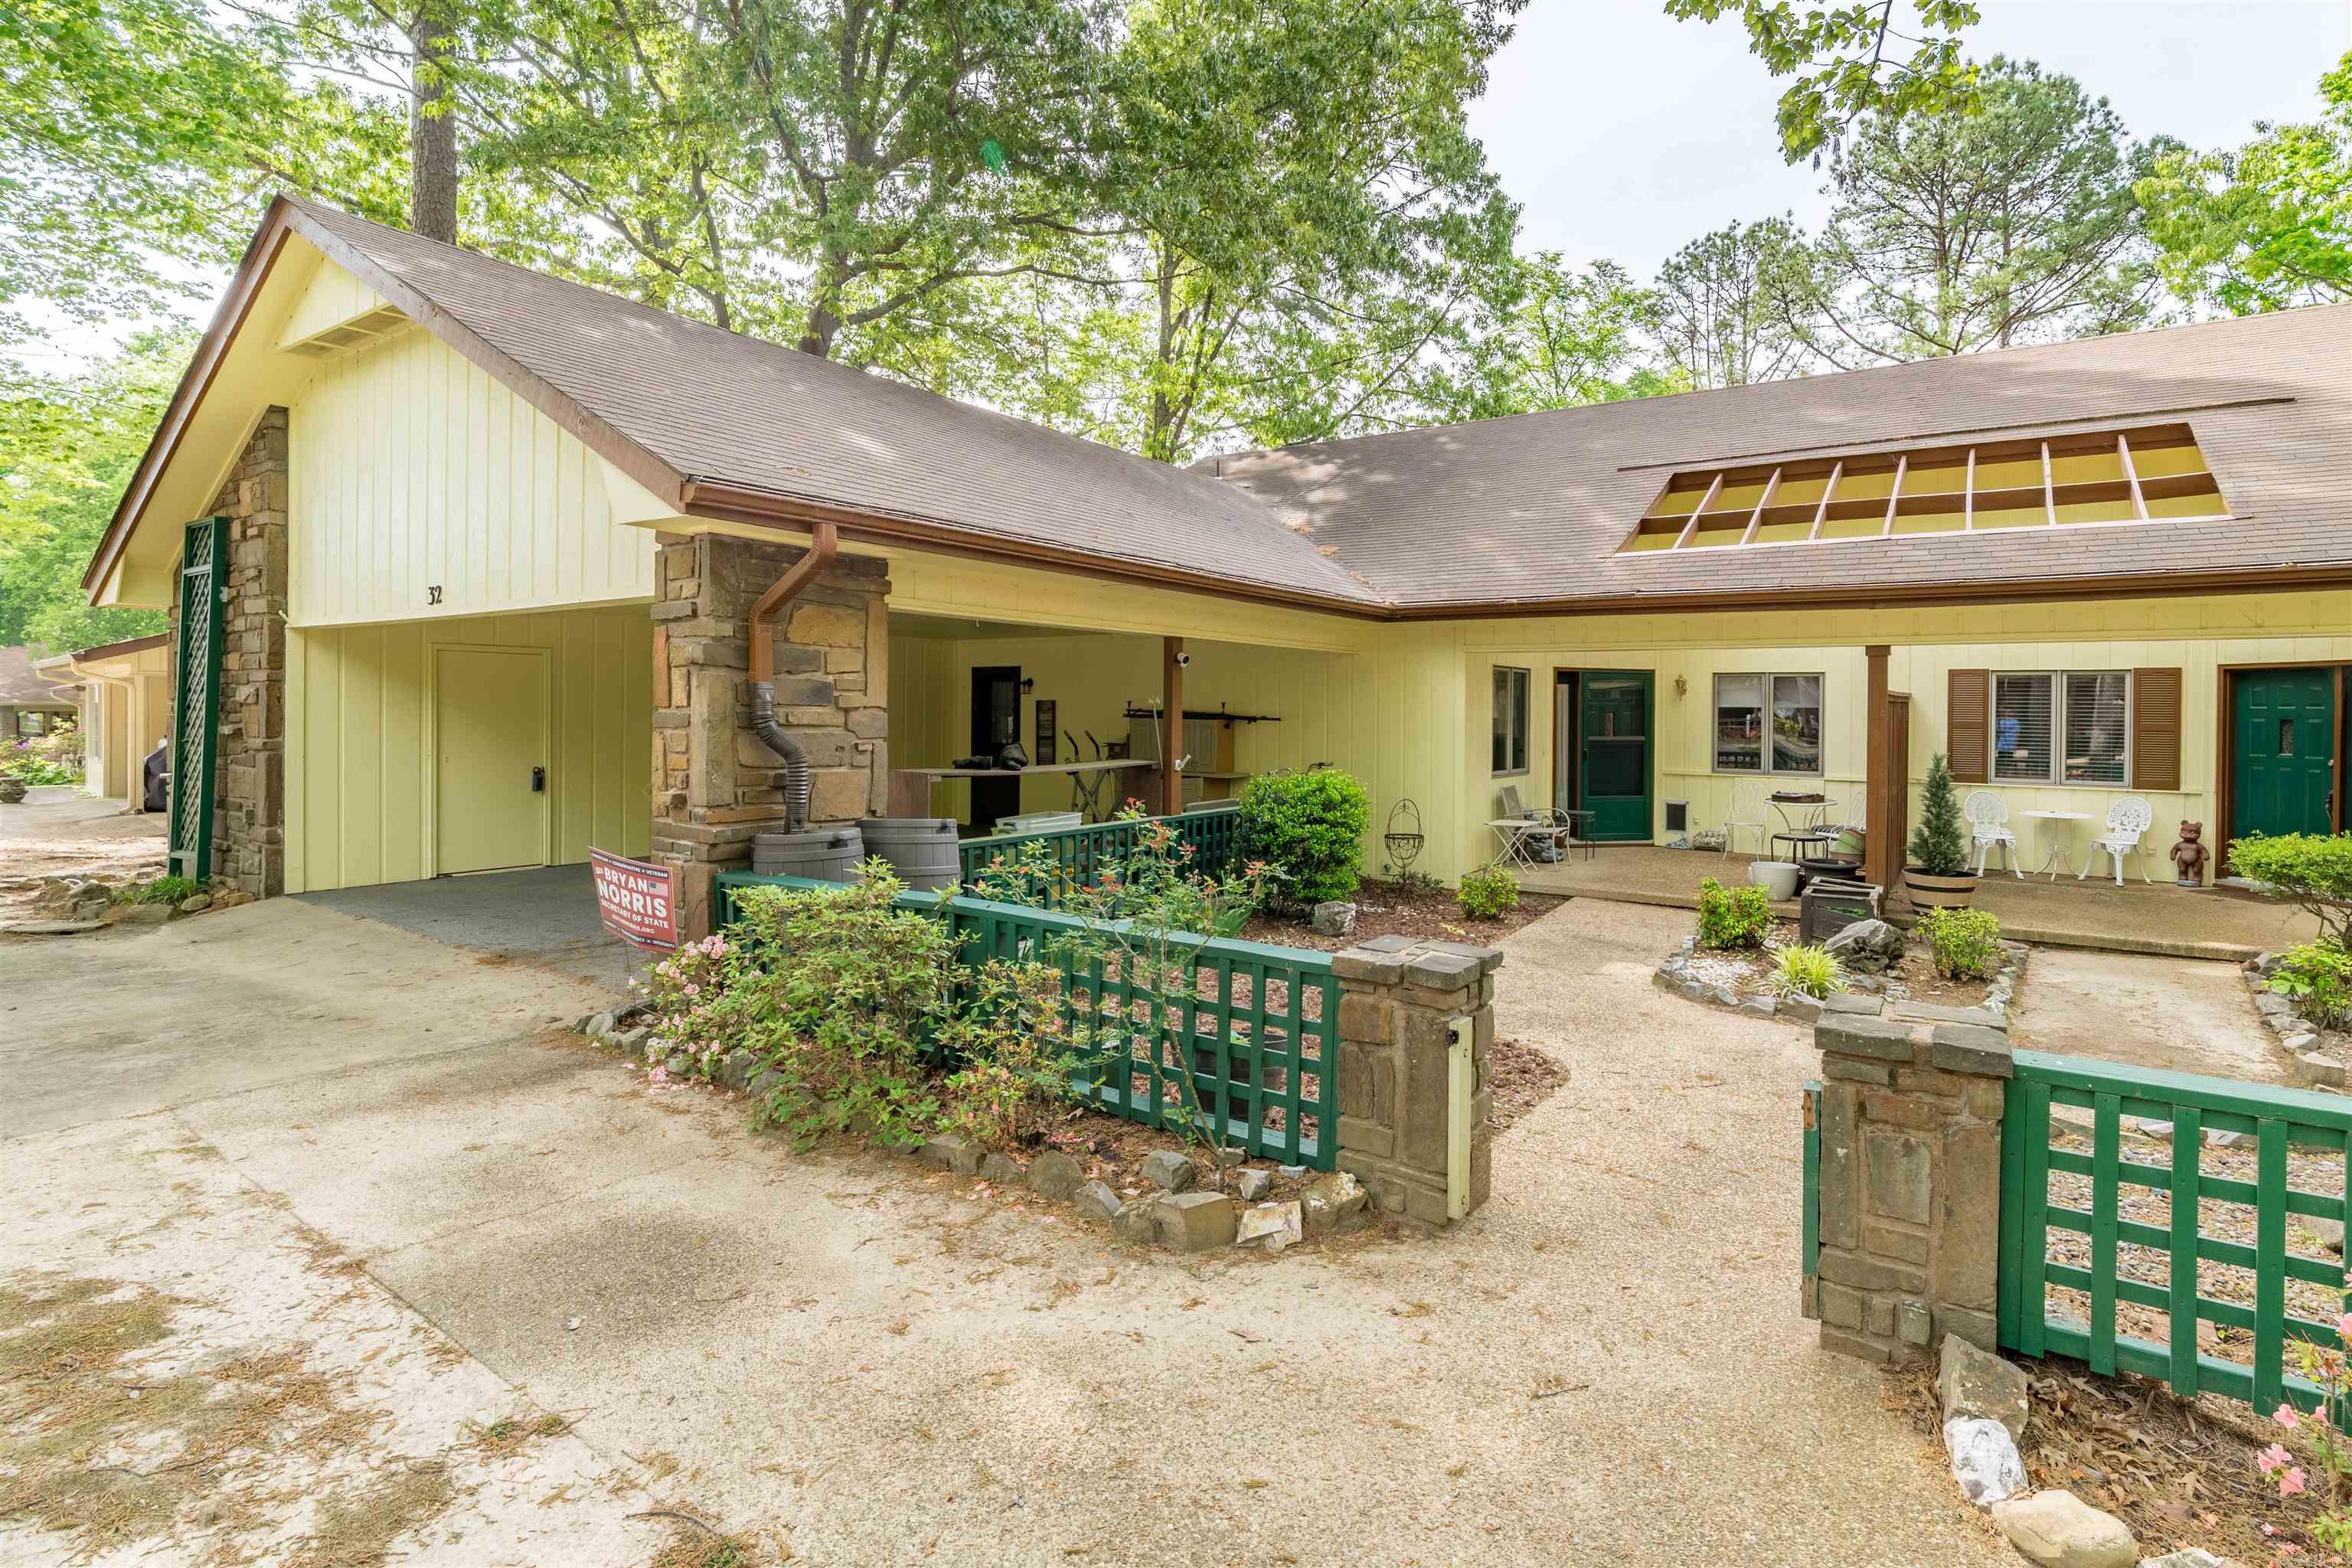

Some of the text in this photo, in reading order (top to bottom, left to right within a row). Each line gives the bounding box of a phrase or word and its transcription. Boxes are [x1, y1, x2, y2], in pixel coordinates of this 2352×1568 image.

[428, 585, 442, 605] 32
[603, 867, 648, 893] BRYAN
[646, 869, 668, 877] VETERAN
[597, 878, 667, 918] NORRIS
[601, 899, 631, 918] SECRETARY
[632, 914, 642, 923] OF
[644, 917, 669, 928] STATE
